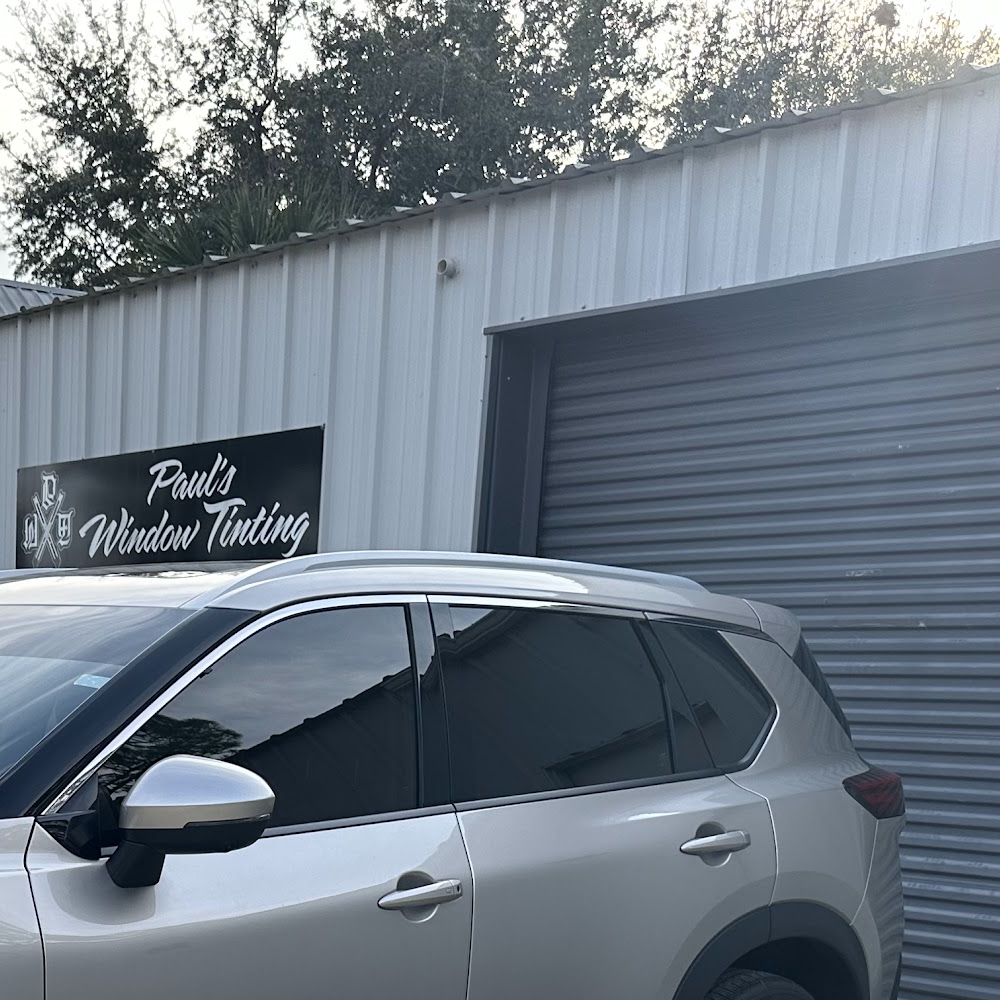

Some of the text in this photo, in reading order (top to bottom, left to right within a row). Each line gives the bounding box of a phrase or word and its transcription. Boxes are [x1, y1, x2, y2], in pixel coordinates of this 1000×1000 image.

[147, 452, 237, 505] Paul's
[79, 497, 310, 558] Window Tinting
